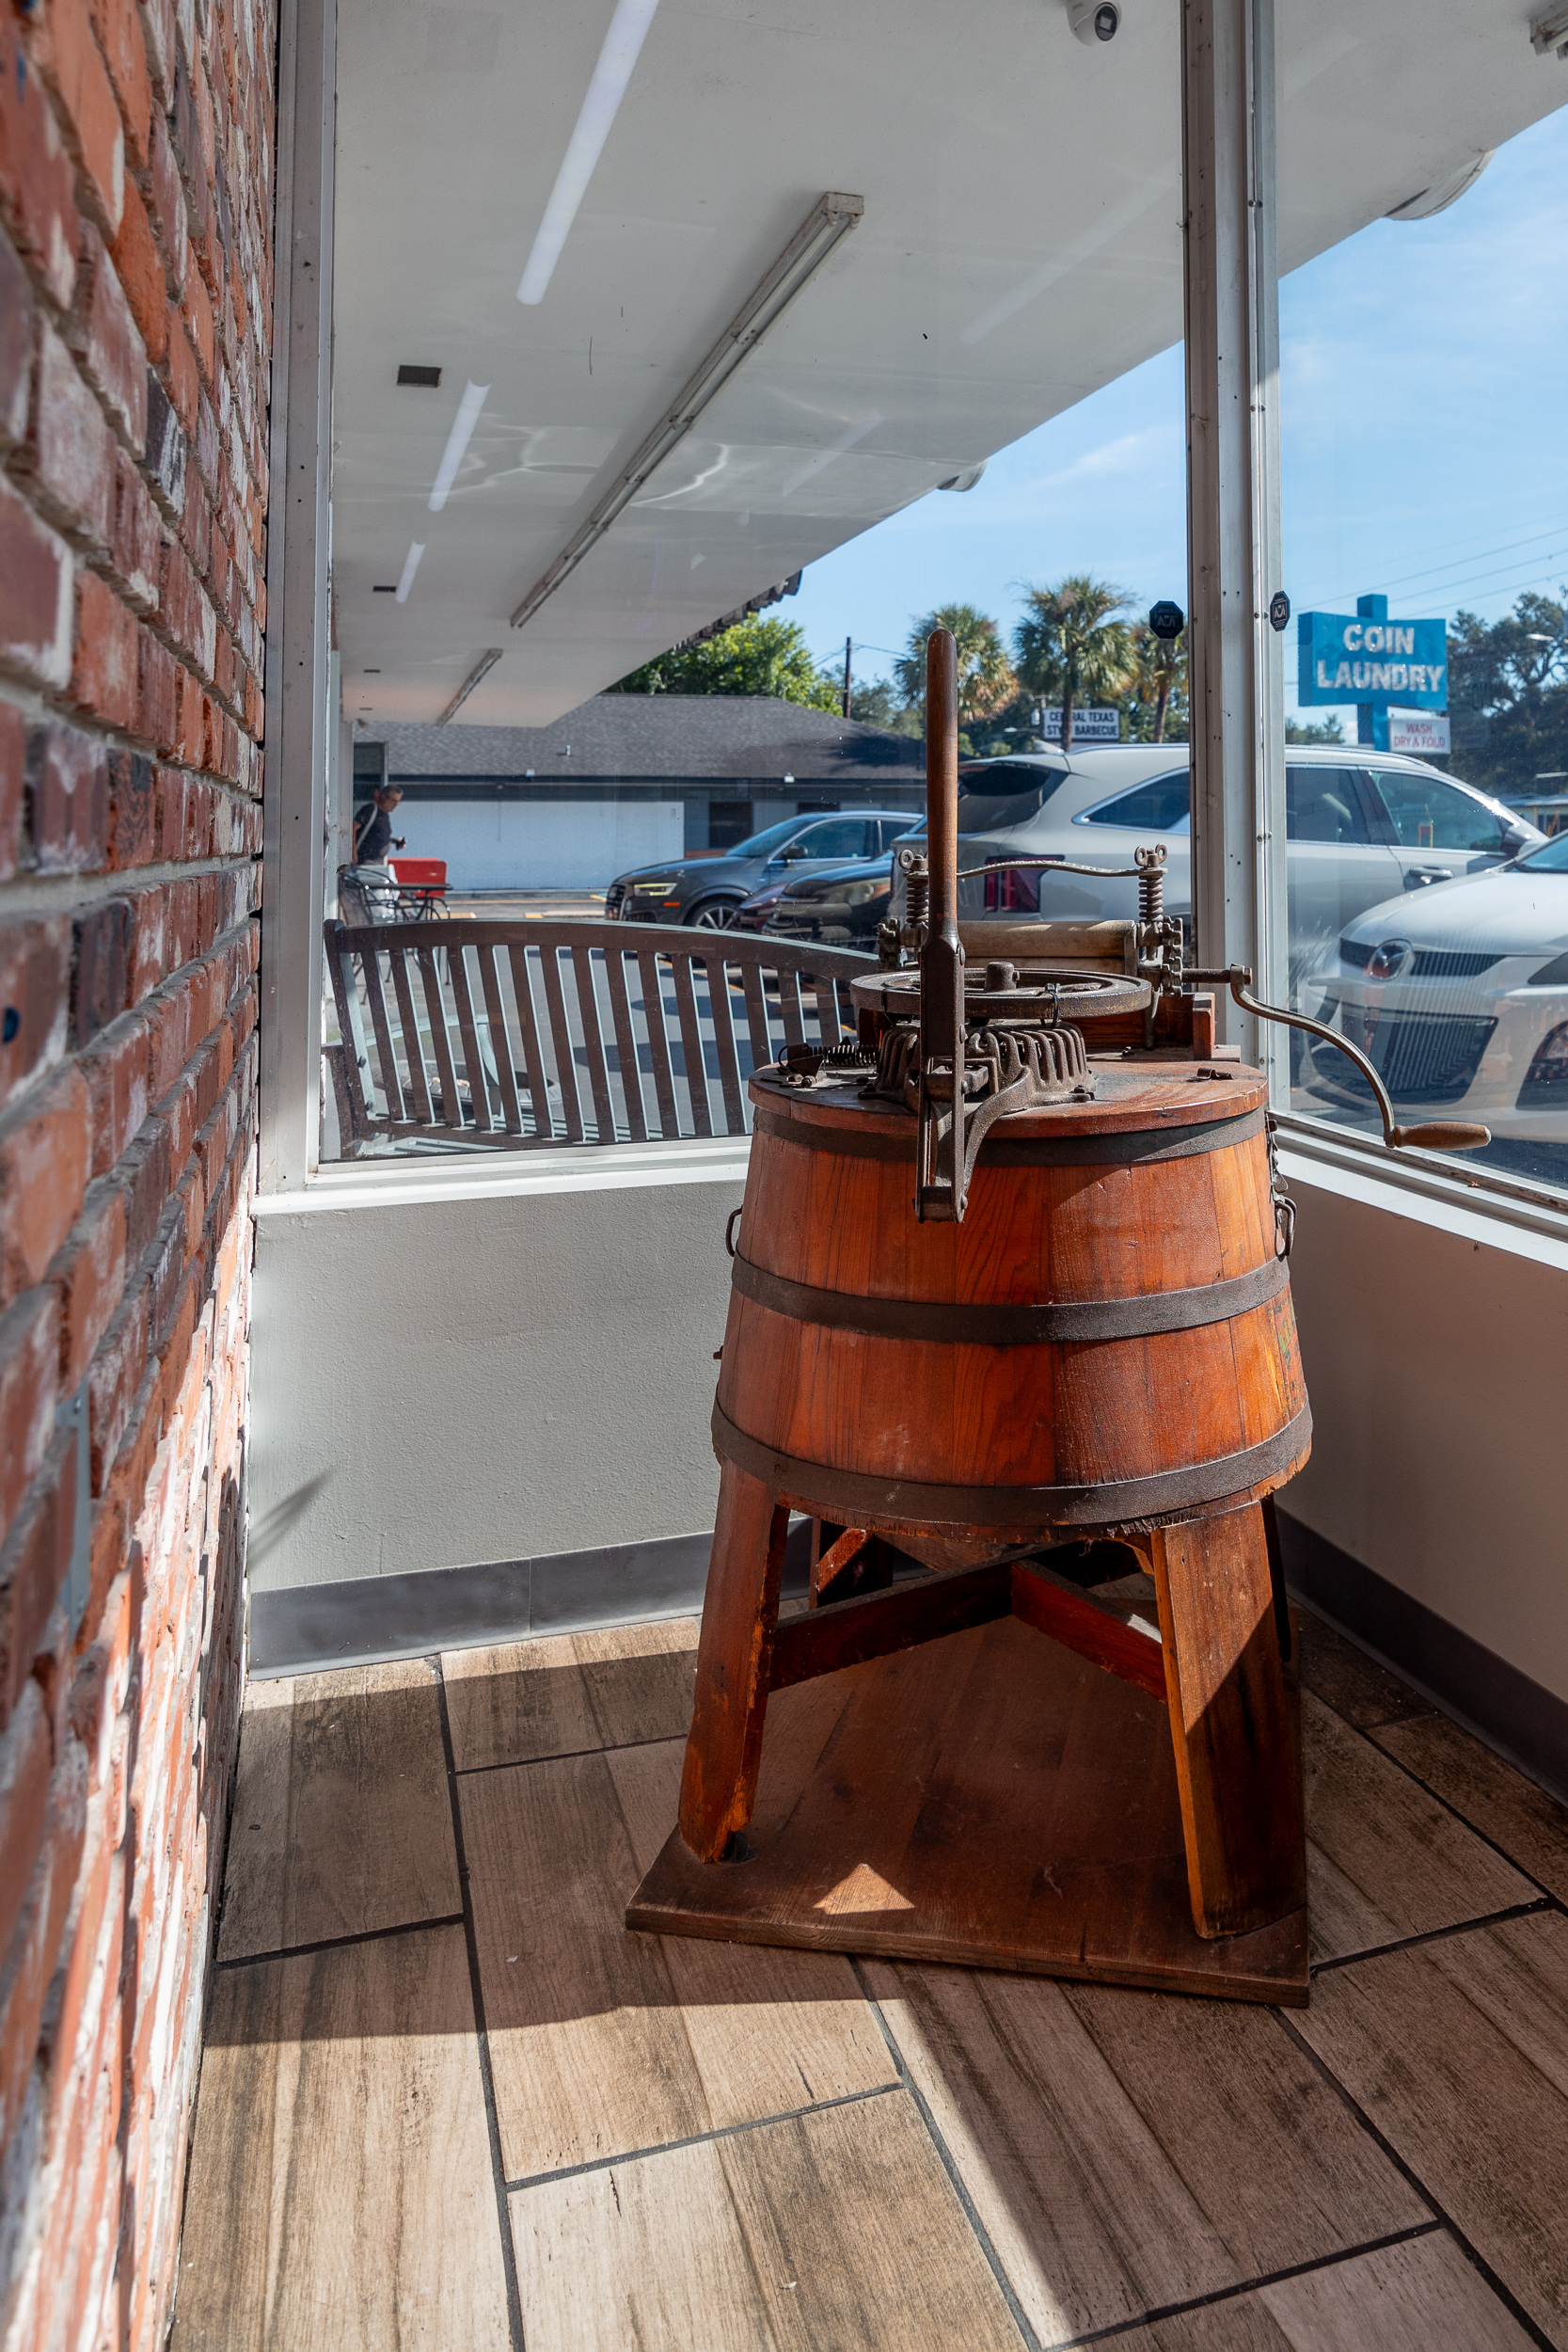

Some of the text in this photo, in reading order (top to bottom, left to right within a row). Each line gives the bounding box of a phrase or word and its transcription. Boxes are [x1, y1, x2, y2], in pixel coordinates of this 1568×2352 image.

[1342, 624, 1415, 655] COIN
[1317, 660, 1445, 692] LAUNDRY
[1089, 711, 1115, 723] TEXAS
[1074, 725, 1117, 737] BARBECUE
[1406, 723, 1433, 735] WASH
[1393, 735, 1411, 747] DRY
[1421, 736, 1446, 749] FOLD
